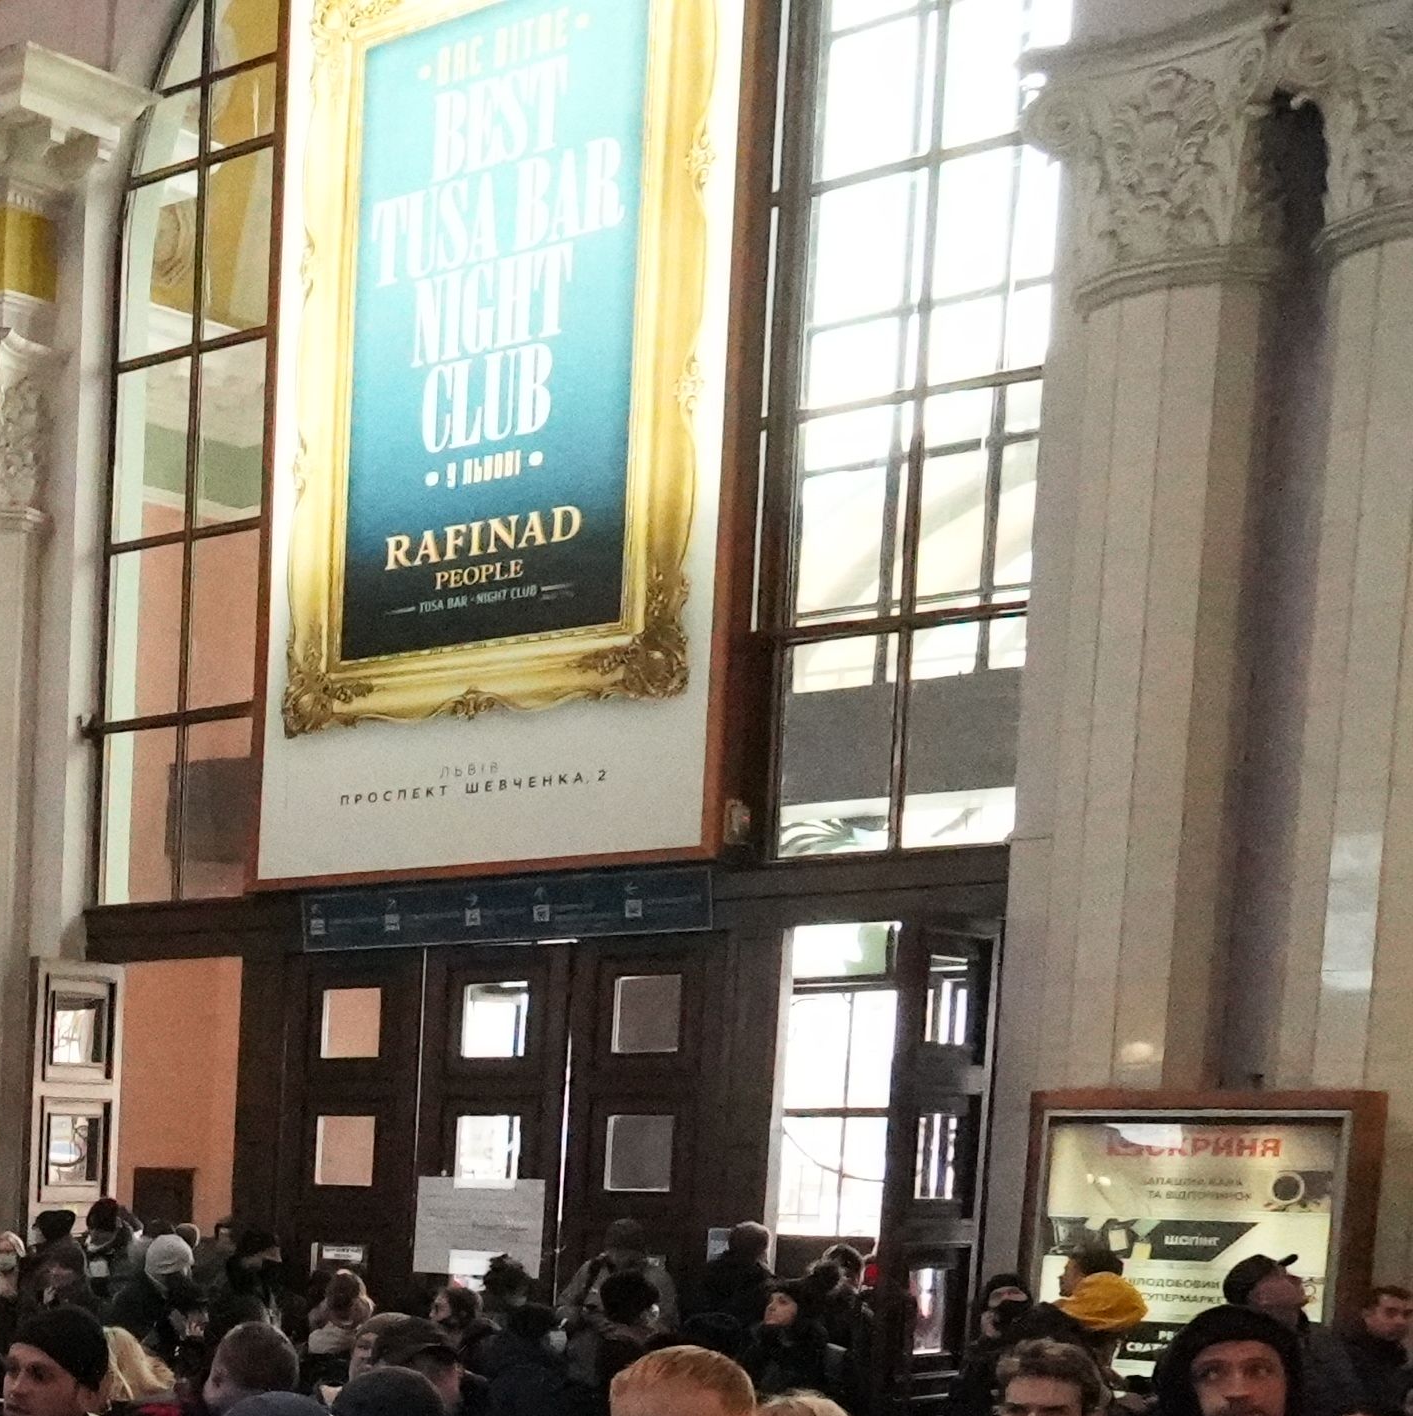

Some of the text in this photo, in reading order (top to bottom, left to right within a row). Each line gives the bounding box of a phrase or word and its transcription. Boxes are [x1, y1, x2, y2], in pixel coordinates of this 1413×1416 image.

[430, 54, 569, 184] BEST
[370, 136, 625, 289] TUSA BAR
[409, 242, 574, 370] NIGHT
[420, 342, 555, 454] CLUB
[462, 450, 522, 486] ЛЬВОВІ
[384, 505, 583, 572] RAFINAD
[434, 559, 525, 590] PEOPLE
[419, 585, 538, 614] TUSA BAR NIGHT CLUB
[339, 785, 449, 806] ПРОСПЕКТ
[597, 769, 607, 782] 2
[439, 761, 500, 780] ЛЬВІВ
[1141, 1291, 1224, 1304] СУПЕРМАРКЕ
